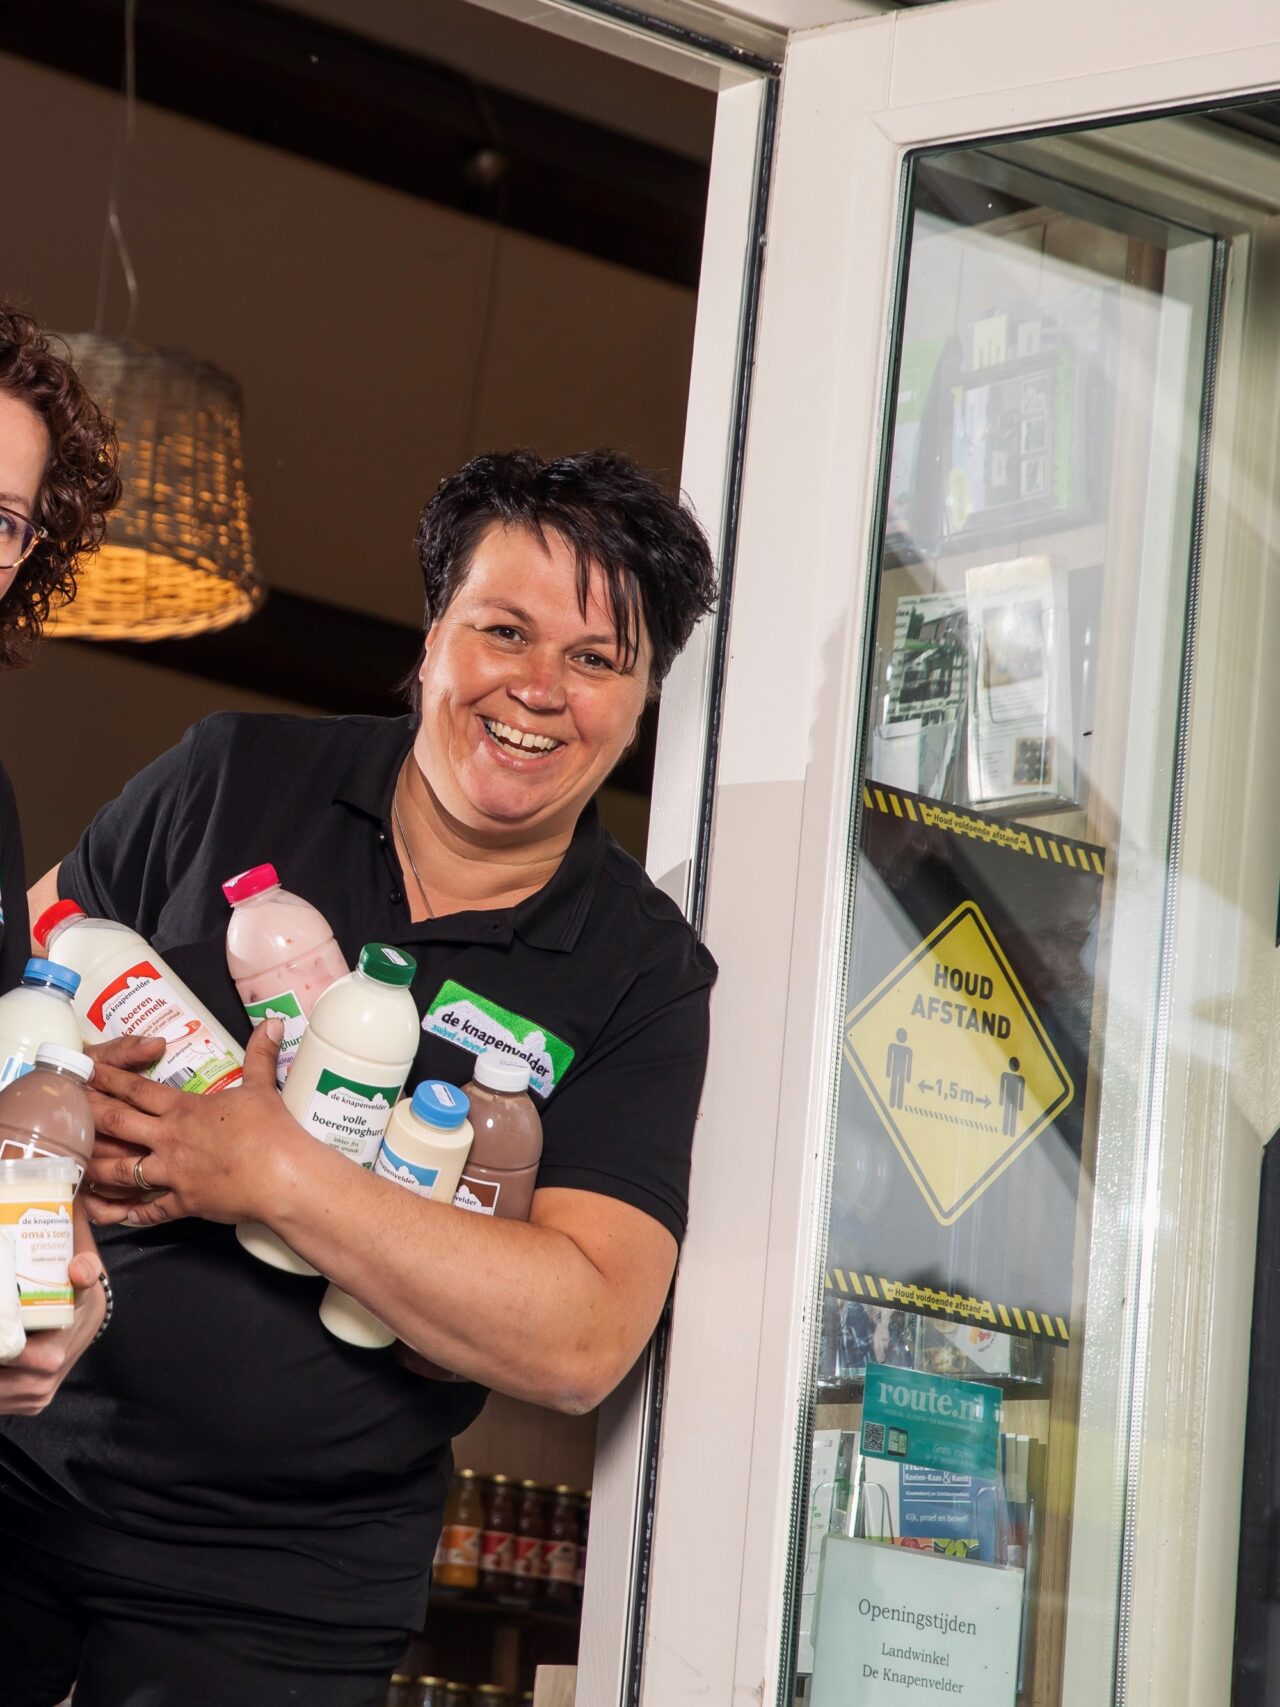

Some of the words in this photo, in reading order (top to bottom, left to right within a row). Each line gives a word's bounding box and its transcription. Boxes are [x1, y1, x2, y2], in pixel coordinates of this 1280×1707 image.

[933, 814, 952, 825] Houd
[954, 821, 991, 836] voldoende
[992, 832, 1019, 845] afstand
[934, 963, 993, 1000] HOUD
[105, 1013, 113, 1021] de
[111, 979, 151, 1013] knapenvelder
[120, 996, 154, 1025] boeren
[121, 998, 168, 1037] karnemelk
[910, 993, 1011, 1040] AFSTAND
[441, 1011, 460, 1027] de
[461, 1020, 550, 1077] knapenvelder
[331, 1093, 340, 1101] de
[341, 1096, 387, 1110] knapenvelder
[312, 1112, 384, 1138] boerenyoghurt
[342, 1114, 367, 1126] volle
[455, 1196, 477, 1207] velder
[21, 1228, 51, 1239] oma's
[22, 1217, 32, 1225] de
[895, 1289, 915, 1299] Houd
[916, 1294, 954, 1308] voldoende
[954, 1302, 982, 1313] afstand
[878, 1382, 985, 1423] route.nl
[858, 1598, 976, 1635] Openingstijden
[881, 1642, 950, 1667] Landwinkel
[862, 1664, 879, 1679] De
[882, 1667, 964, 1694] Knapenvelder
